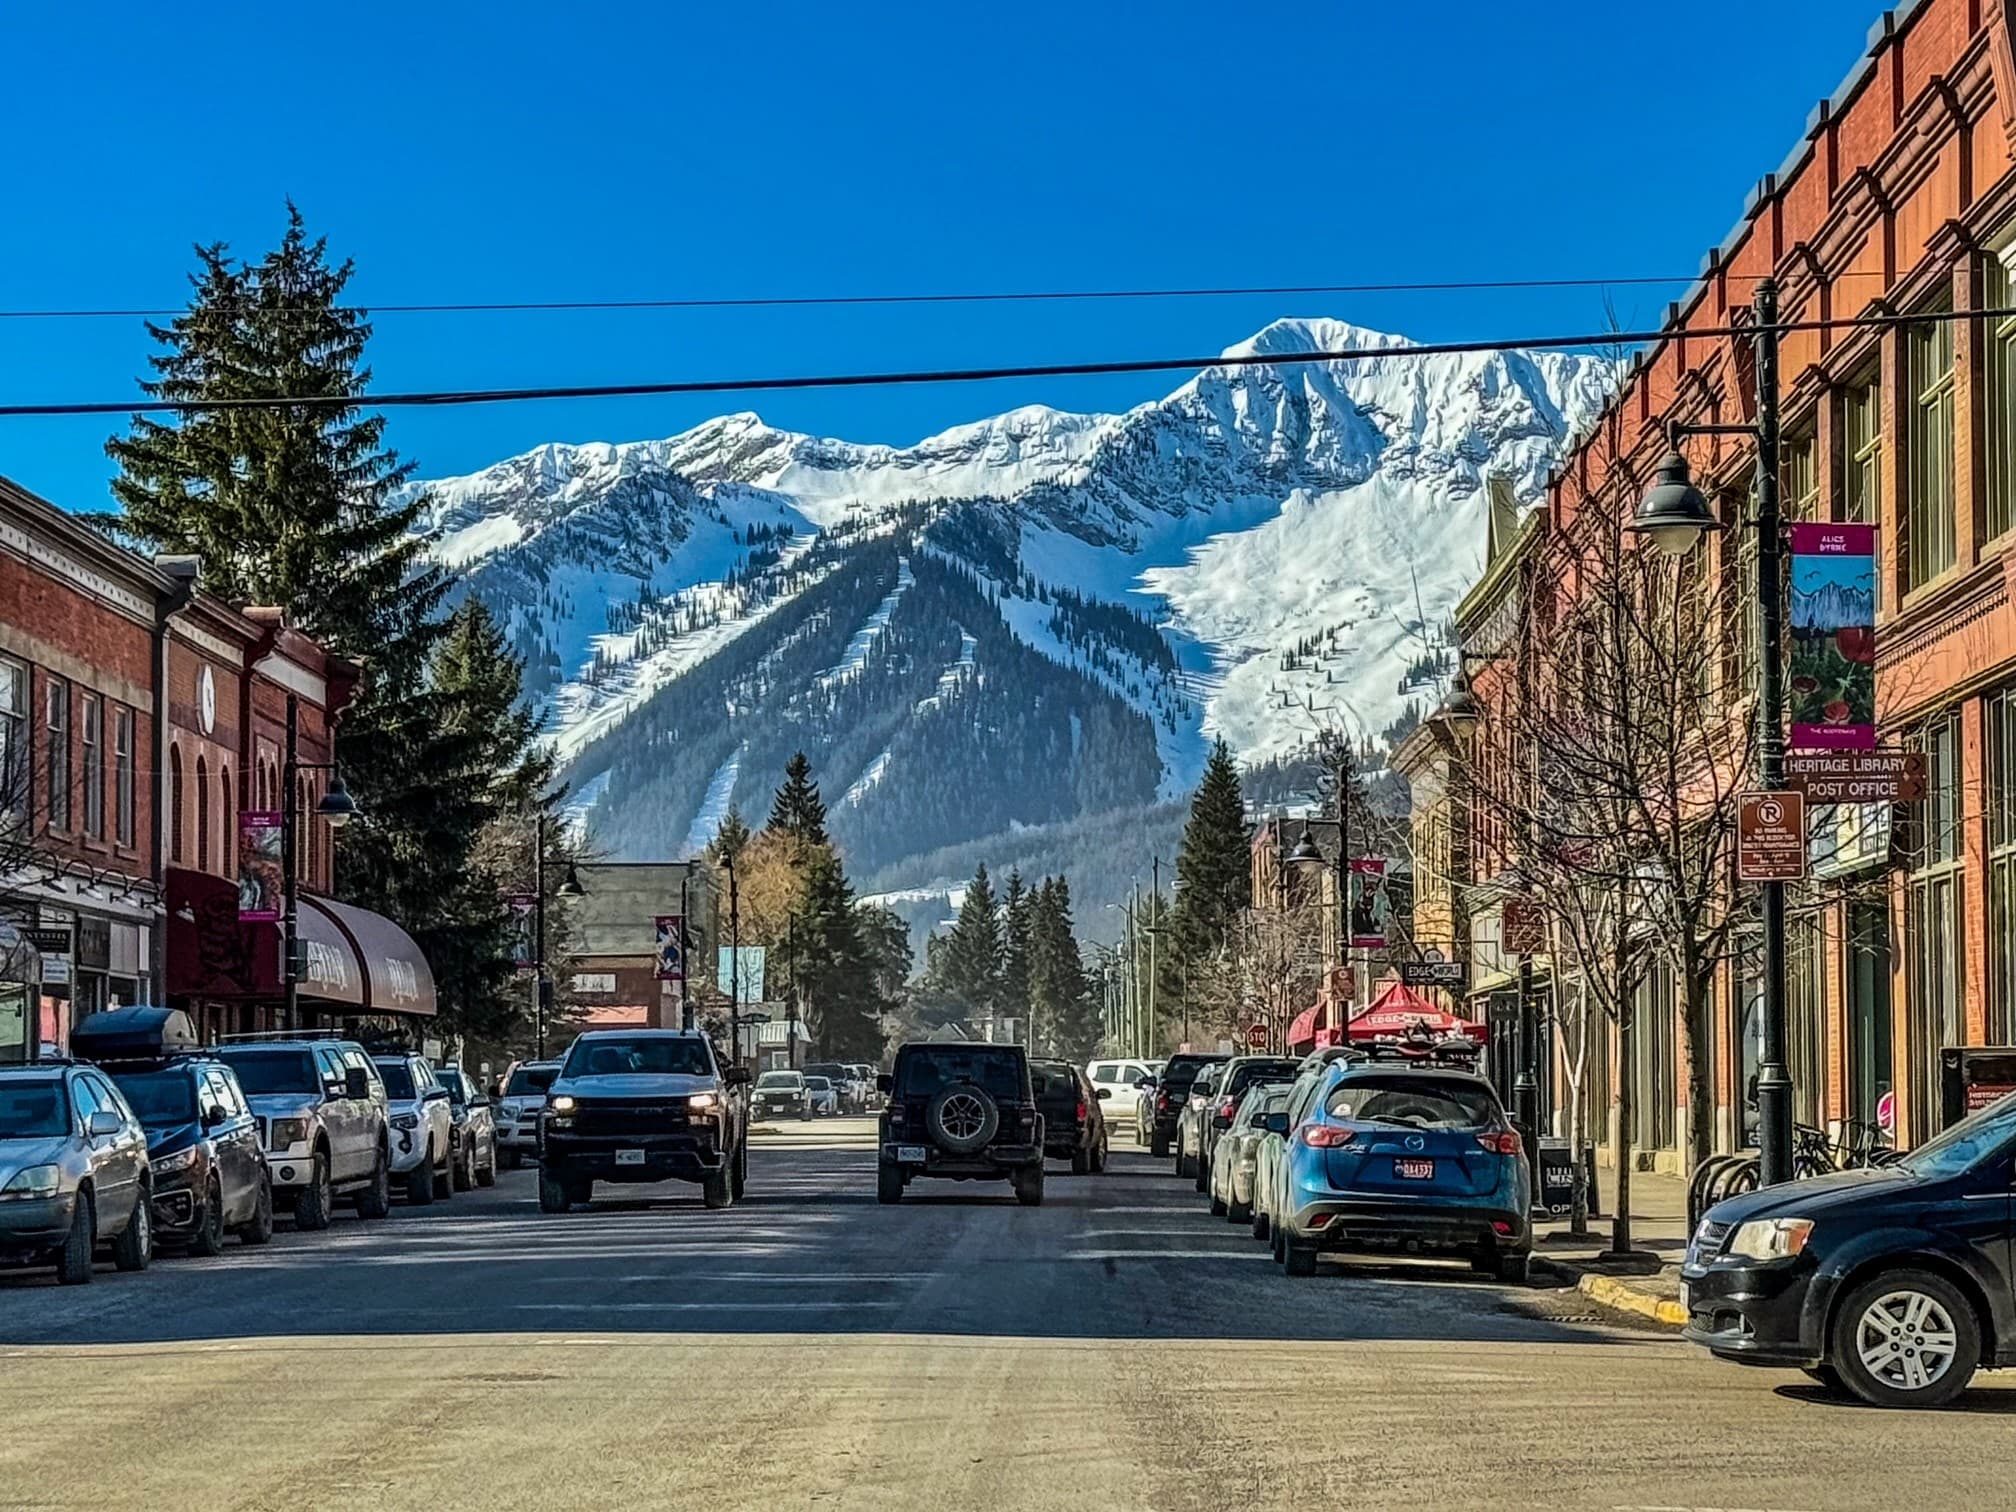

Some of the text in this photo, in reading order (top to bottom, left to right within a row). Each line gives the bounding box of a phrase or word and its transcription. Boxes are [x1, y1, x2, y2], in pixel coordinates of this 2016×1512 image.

[1790, 758, 1907, 773] HERITAGE LIBRARY
[1807, 782, 1899, 796] POST OFFICE
[1250, 1031, 1265, 1042] STO
